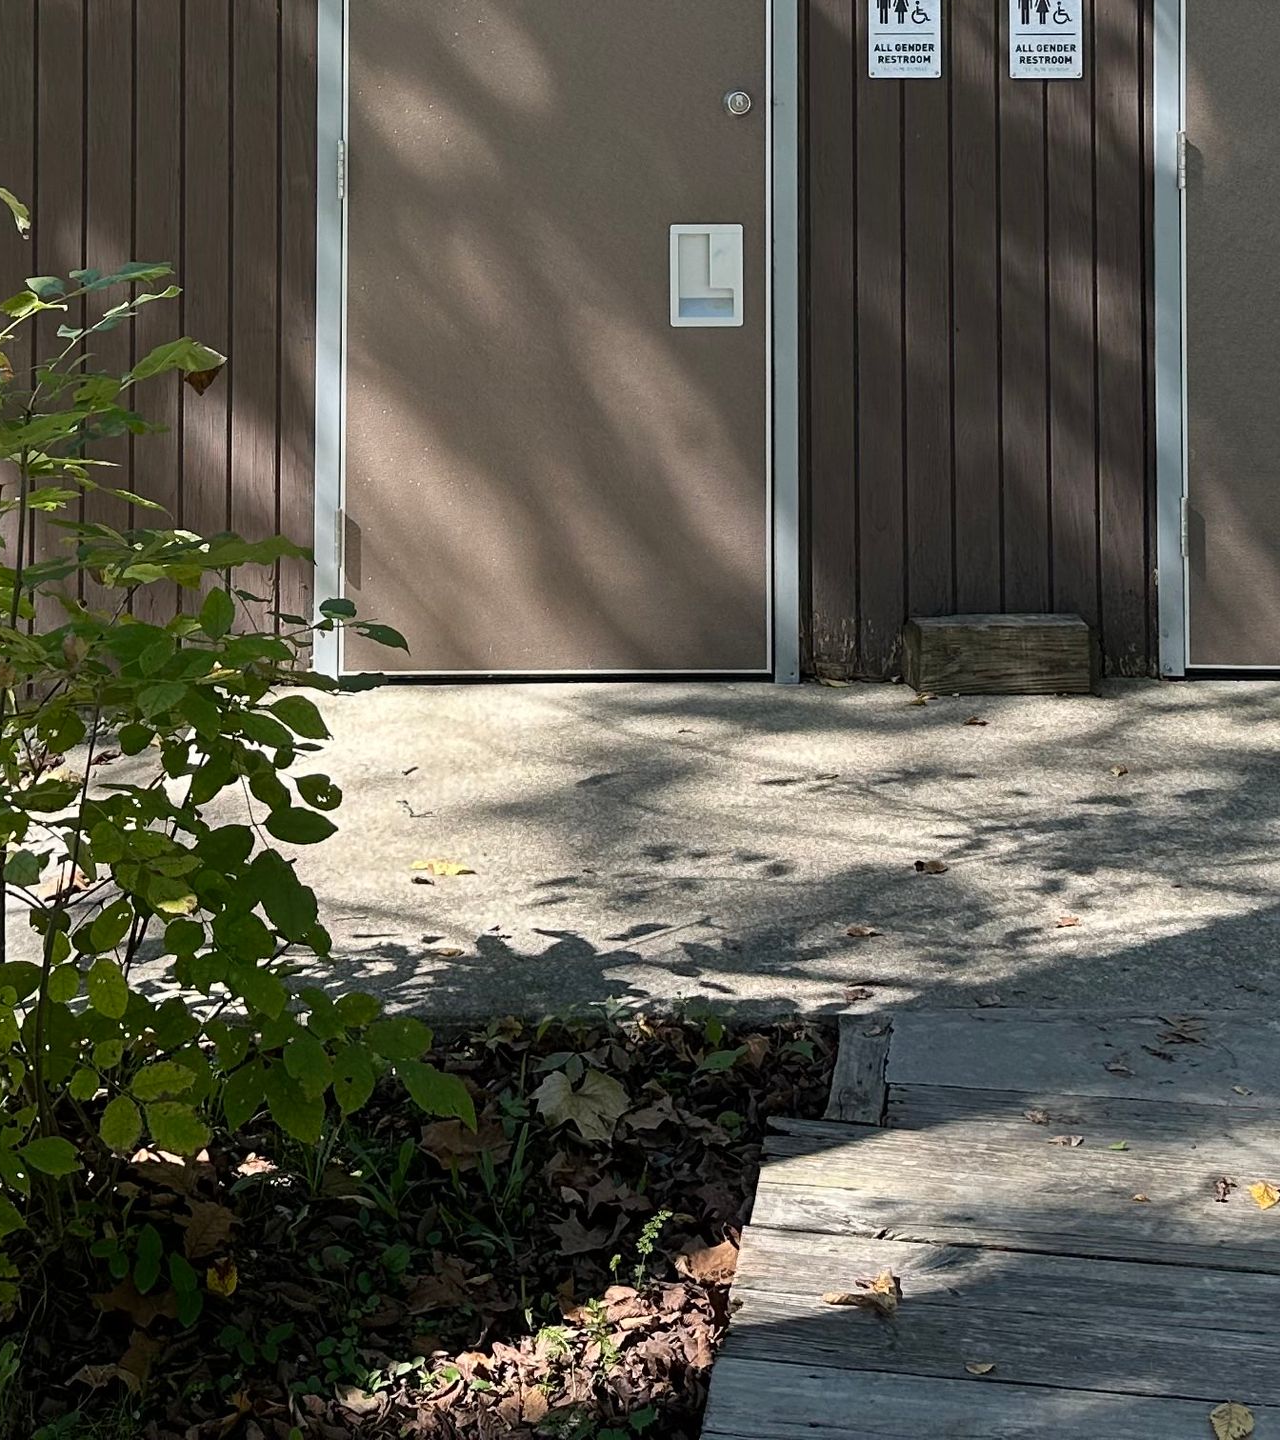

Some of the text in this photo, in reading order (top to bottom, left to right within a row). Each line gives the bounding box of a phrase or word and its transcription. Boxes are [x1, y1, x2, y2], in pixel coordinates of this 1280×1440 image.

[874, 43, 935, 53] ALL GENDER
[1015, 43, 1077, 53] ALL GENDER
[877, 55, 931, 65] RESTROOM
[1019, 56, 1073, 66] RESTROOM
